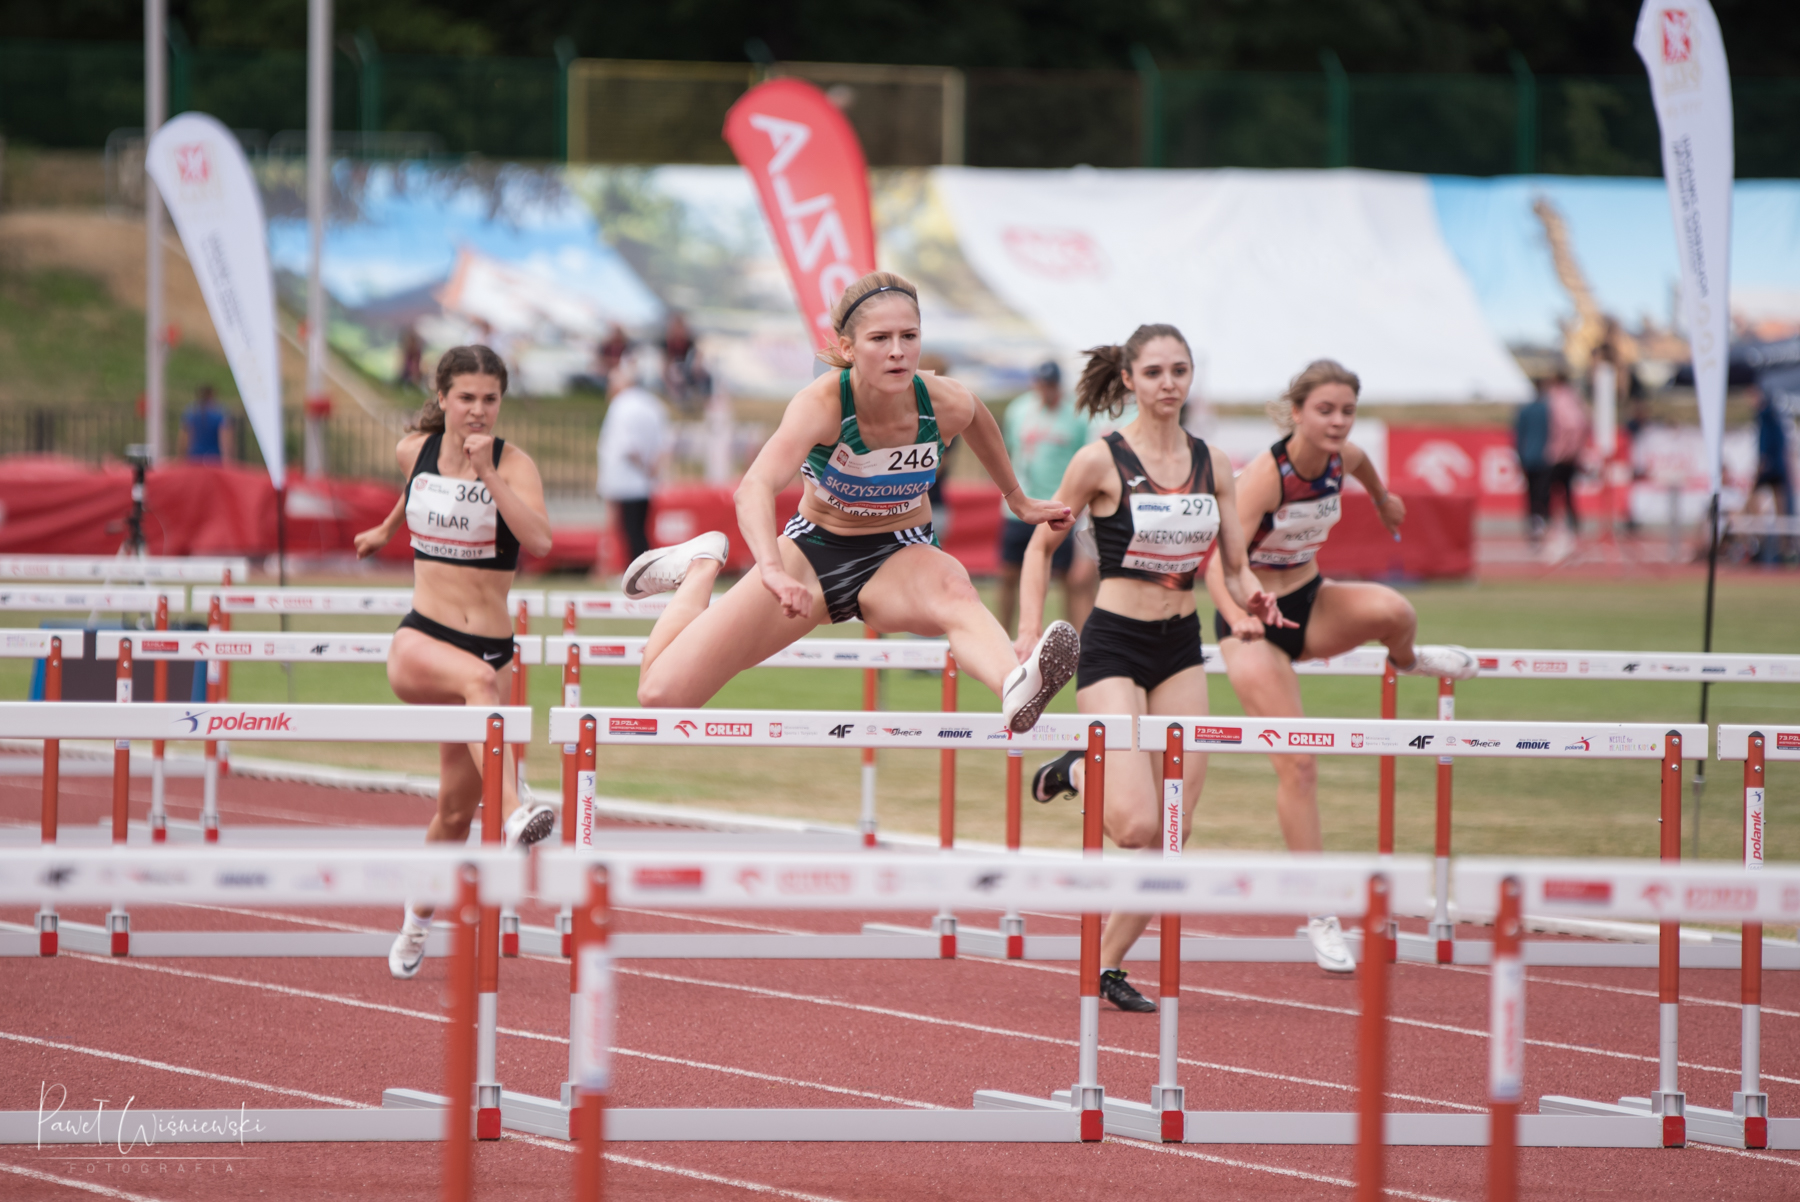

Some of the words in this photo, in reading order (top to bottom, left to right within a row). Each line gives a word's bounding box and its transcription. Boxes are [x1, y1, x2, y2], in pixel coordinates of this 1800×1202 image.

[887, 446, 935, 471] 246
[454, 484, 493, 505] 360
[825, 475, 930, 498] SKRZYSZOWSKA
[1180, 498, 1213, 516] 297
[428, 511, 470, 531] FILAR
[1136, 530, 1213, 545] SKIERKOWSKA
[461, 549, 483, 558] 2019
[1134, 560, 1179, 572] RACIBÓRZ
[206, 712, 292, 735] polanik
[707, 724, 750, 736] ORLEN
[828, 724, 854, 738] 4F
[937, 730, 974, 738] 4MOVE
[1290, 734, 1332, 746] ORLEN
[1408, 735, 1434, 749] 4F
[1516, 742, 1551, 750] 4MOVE
[580, 795, 593, 847] polanik
[1167, 803, 1180, 854] polanik
[1750, 810, 1763, 861] polanik
